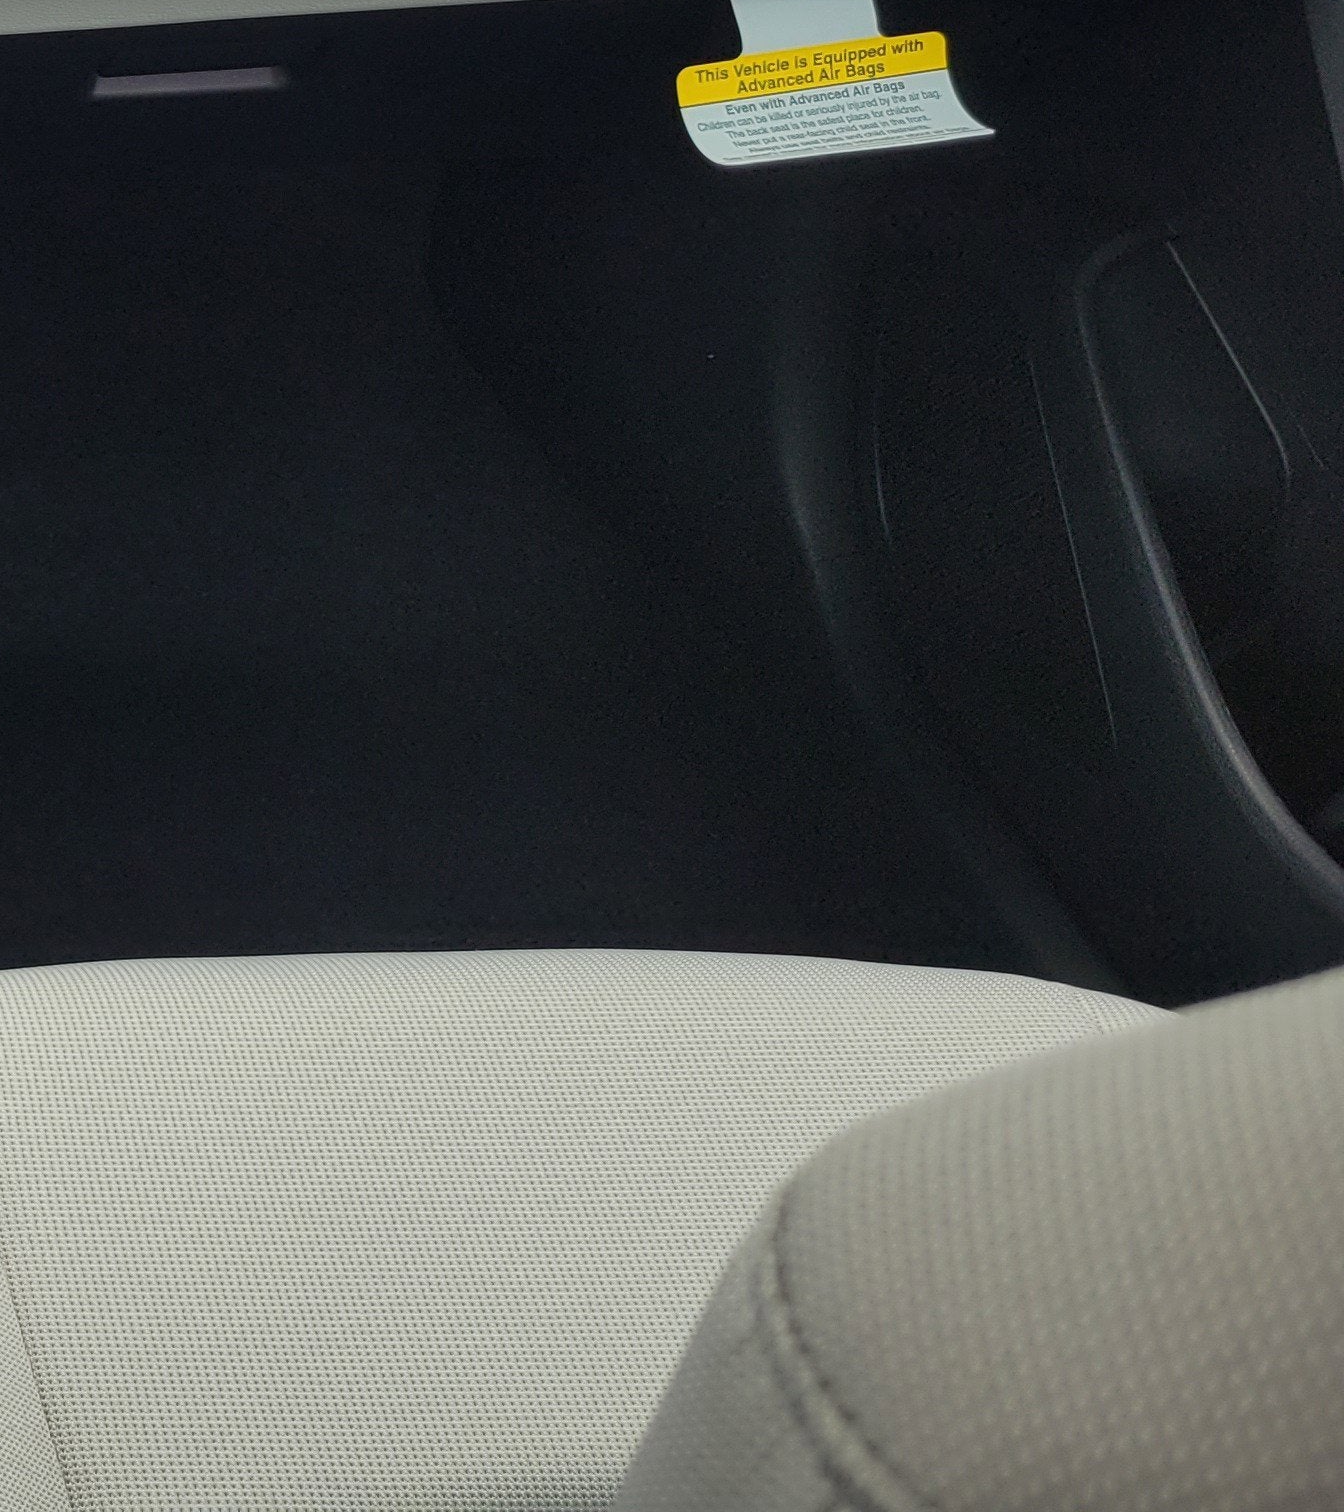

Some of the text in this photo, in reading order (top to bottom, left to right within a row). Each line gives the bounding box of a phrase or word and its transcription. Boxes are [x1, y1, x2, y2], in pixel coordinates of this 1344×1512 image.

[695, 67, 729, 83] This
[733, 59, 789, 77] Vehicle
[813, 43, 886, 66] Equipped
[891, 39, 923, 54] with
[737, 63, 885, 94] Advanced Air Bags
[697, 120, 736, 132] Children
[737, 118, 753, 126] can
[769, 109, 792, 121] killed
[794, 109, 804, 118] or
[805, 103, 845, 117] seriously
[847, 100, 877, 112] injured
[879, 96, 891, 107] by
[892, 94, 907, 102] the
[909, 92, 920, 101] air
[726, 81, 905, 116] Even with Advanced Air Bags
[727, 130, 745, 139] The
[747, 126, 769, 136] back
[770, 124, 790, 133] seat
[800, 119, 815, 128] the
[817, 114, 846, 124] safest
[847, 112, 871, 123] place
[872, 109, 884, 117] for
